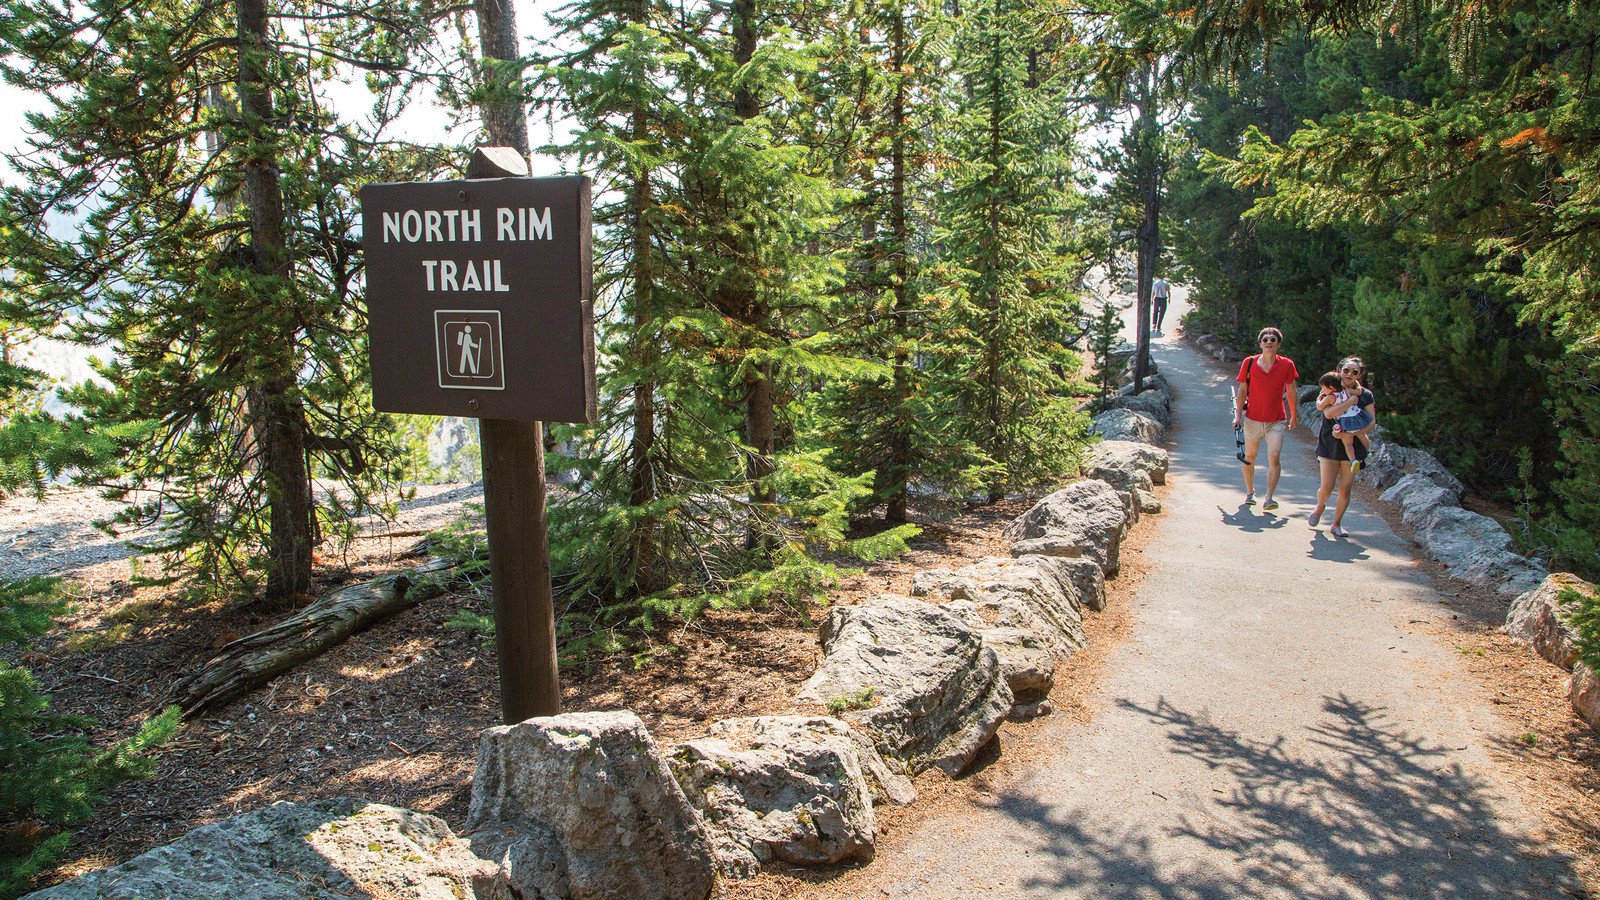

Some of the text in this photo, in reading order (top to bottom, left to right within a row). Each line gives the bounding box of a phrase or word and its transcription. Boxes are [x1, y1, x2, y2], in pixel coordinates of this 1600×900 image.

[382, 206, 553, 243] NORTH RIM
[421, 259, 510, 292] TRAIL
